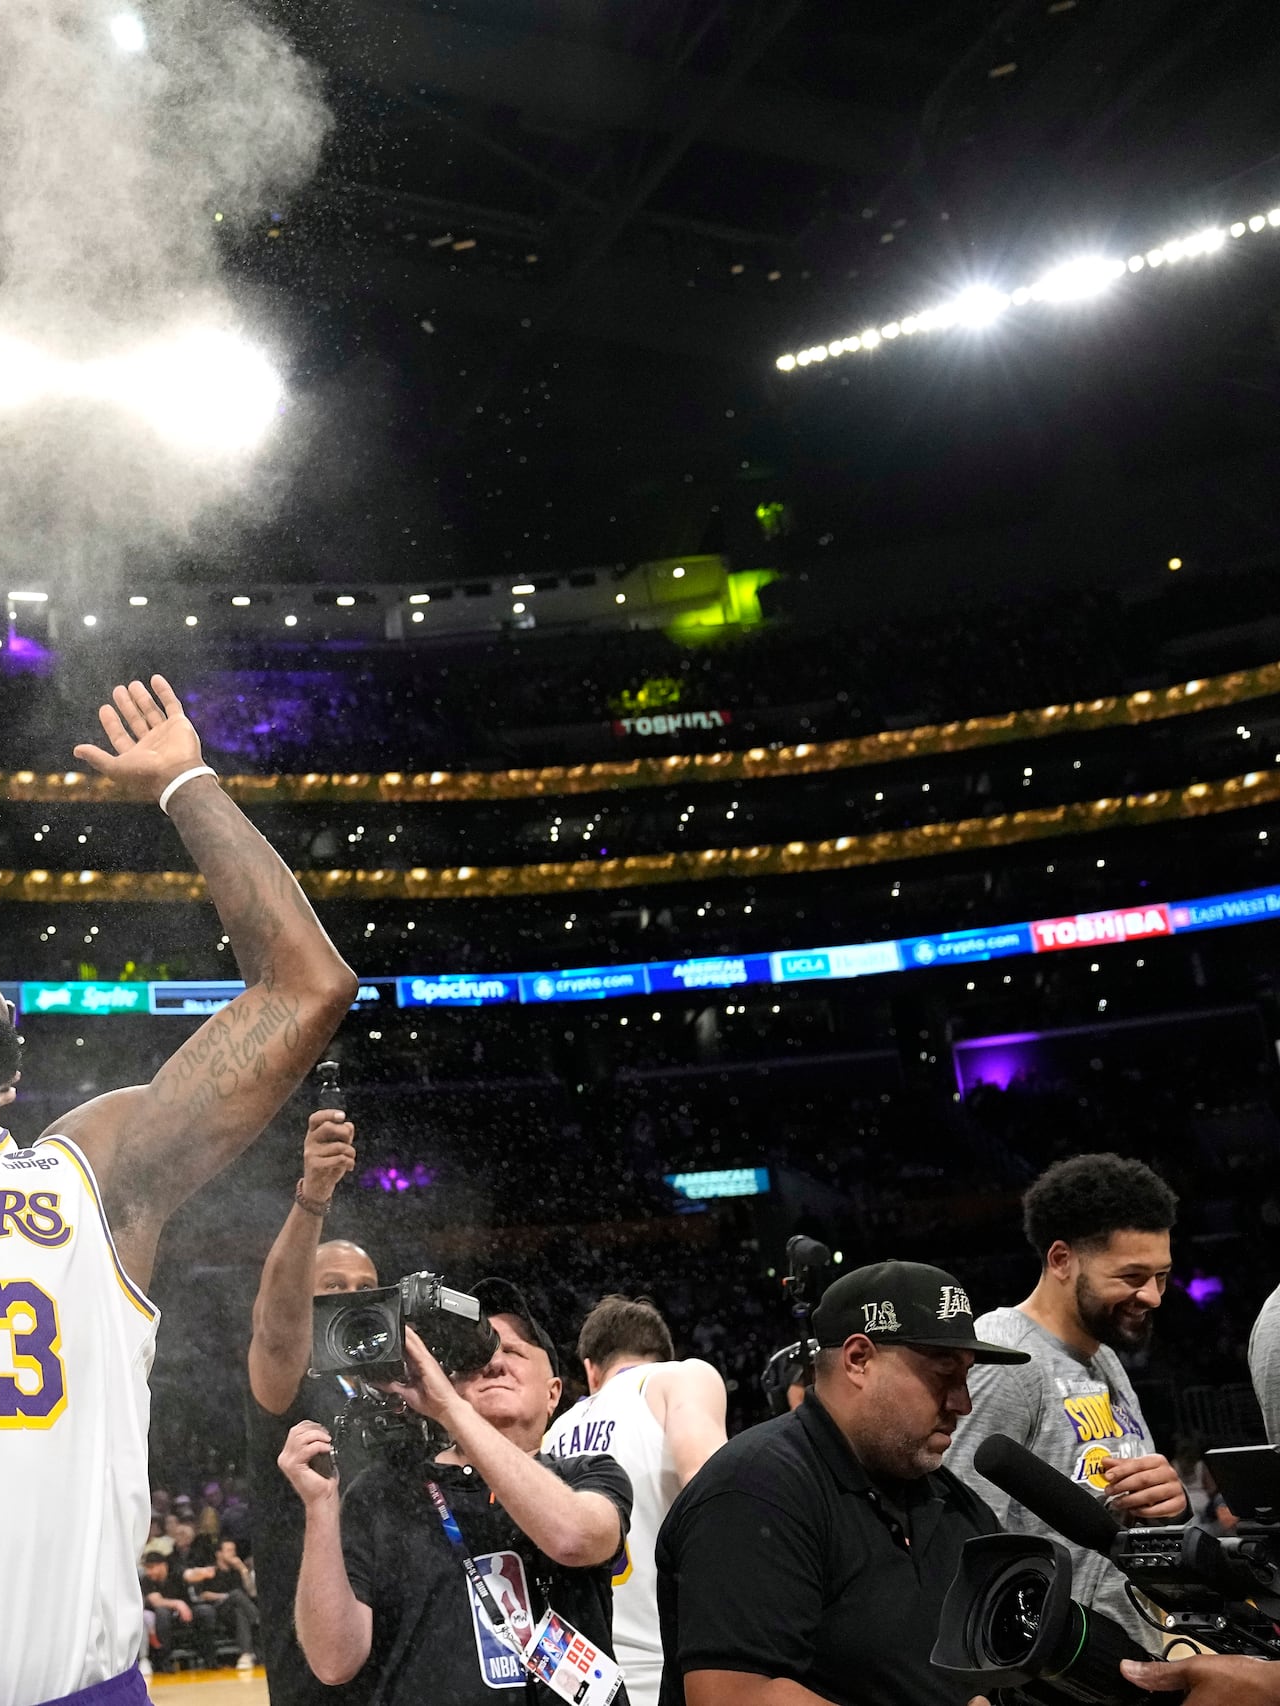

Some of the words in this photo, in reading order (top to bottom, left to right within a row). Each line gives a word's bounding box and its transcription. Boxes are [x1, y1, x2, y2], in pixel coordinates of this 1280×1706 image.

[1036, 908, 1165, 947] TOSHIBA
[937, 932, 1020, 958] crypto.com
[673, 959, 745, 979] AMERICAN
[786, 958, 825, 974] UCLA
[411, 979, 504, 1005] Spectrum
[555, 974, 634, 994] crypto.com
[81, 986, 139, 1011] Sprite
[210, 994, 301, 1100] Eternity
[1, 1155, 60, 1171] bibigo
[489, 1655, 520, 1679] NBA
